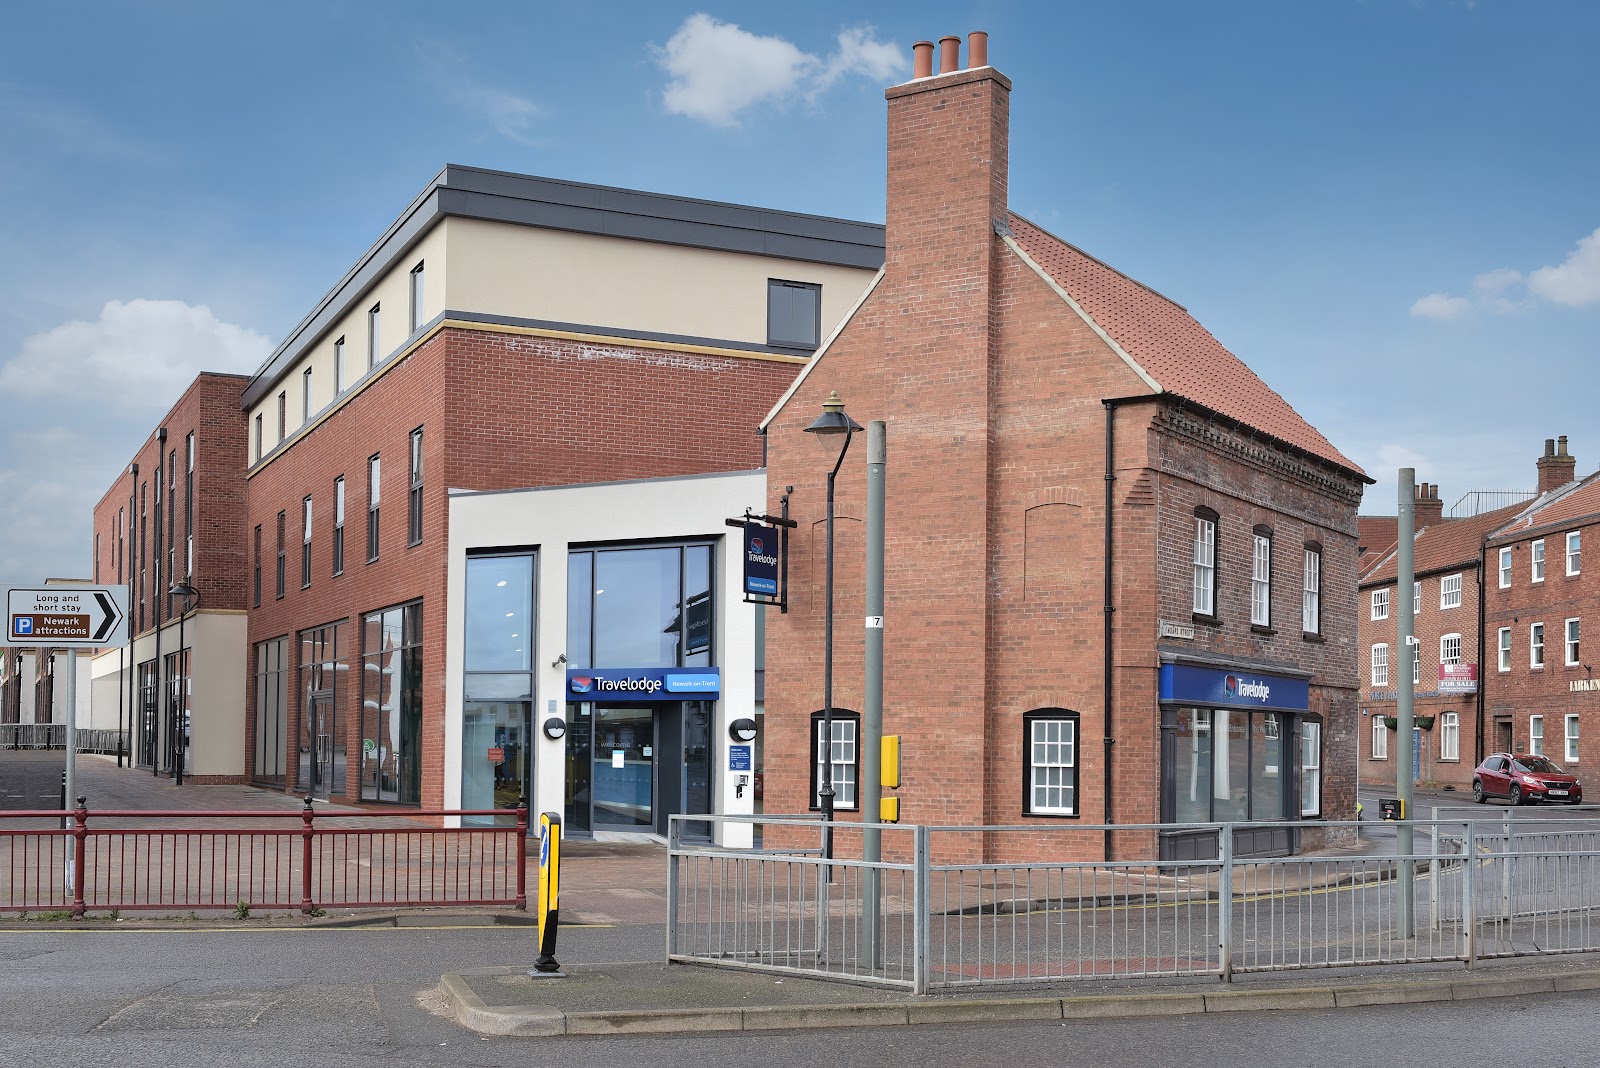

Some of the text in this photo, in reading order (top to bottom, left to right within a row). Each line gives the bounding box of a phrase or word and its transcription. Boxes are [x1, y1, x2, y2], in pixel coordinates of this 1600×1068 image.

[747, 550, 777, 567] Travelodge
[36, 594, 79, 603] Long and
[61, 604, 81, 613] stay
[19, 618, 31, 633] P
[44, 617, 79, 625] Newark
[874, 617, 881, 626] 7
[35, 627, 87, 635] attractions
[594, 676, 716, 694] Travelodge Newark-on-Trent
[1237, 678, 1270, 702] Travelodge
